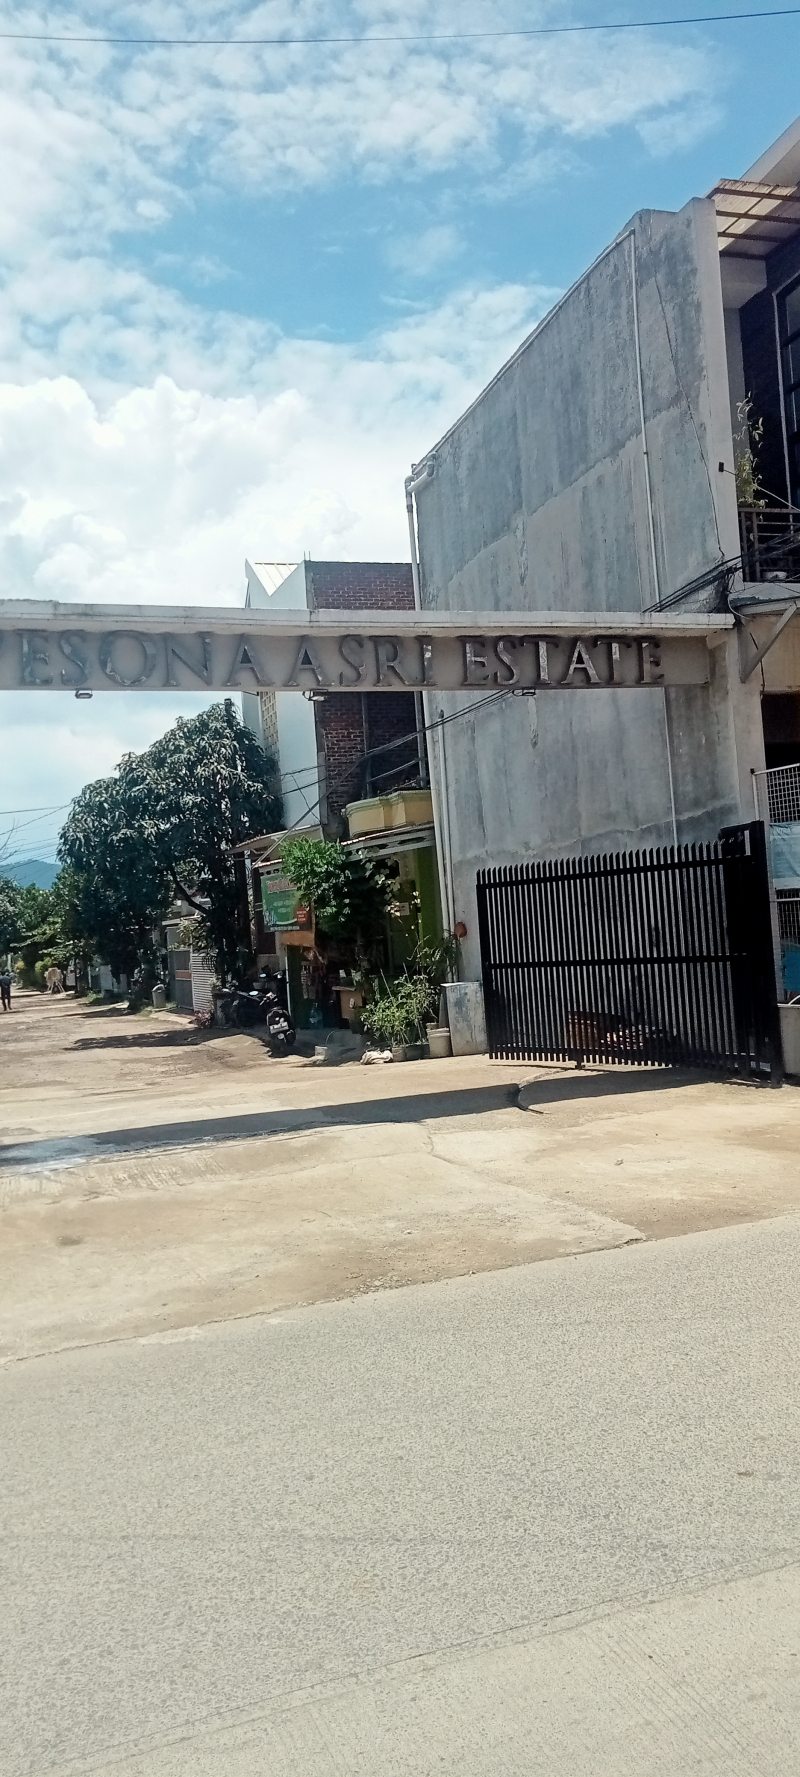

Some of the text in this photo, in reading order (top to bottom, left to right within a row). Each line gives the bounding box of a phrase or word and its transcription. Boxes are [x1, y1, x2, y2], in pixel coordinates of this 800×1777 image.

[0, 629, 664, 687] ESONA ASRI ESTATE
